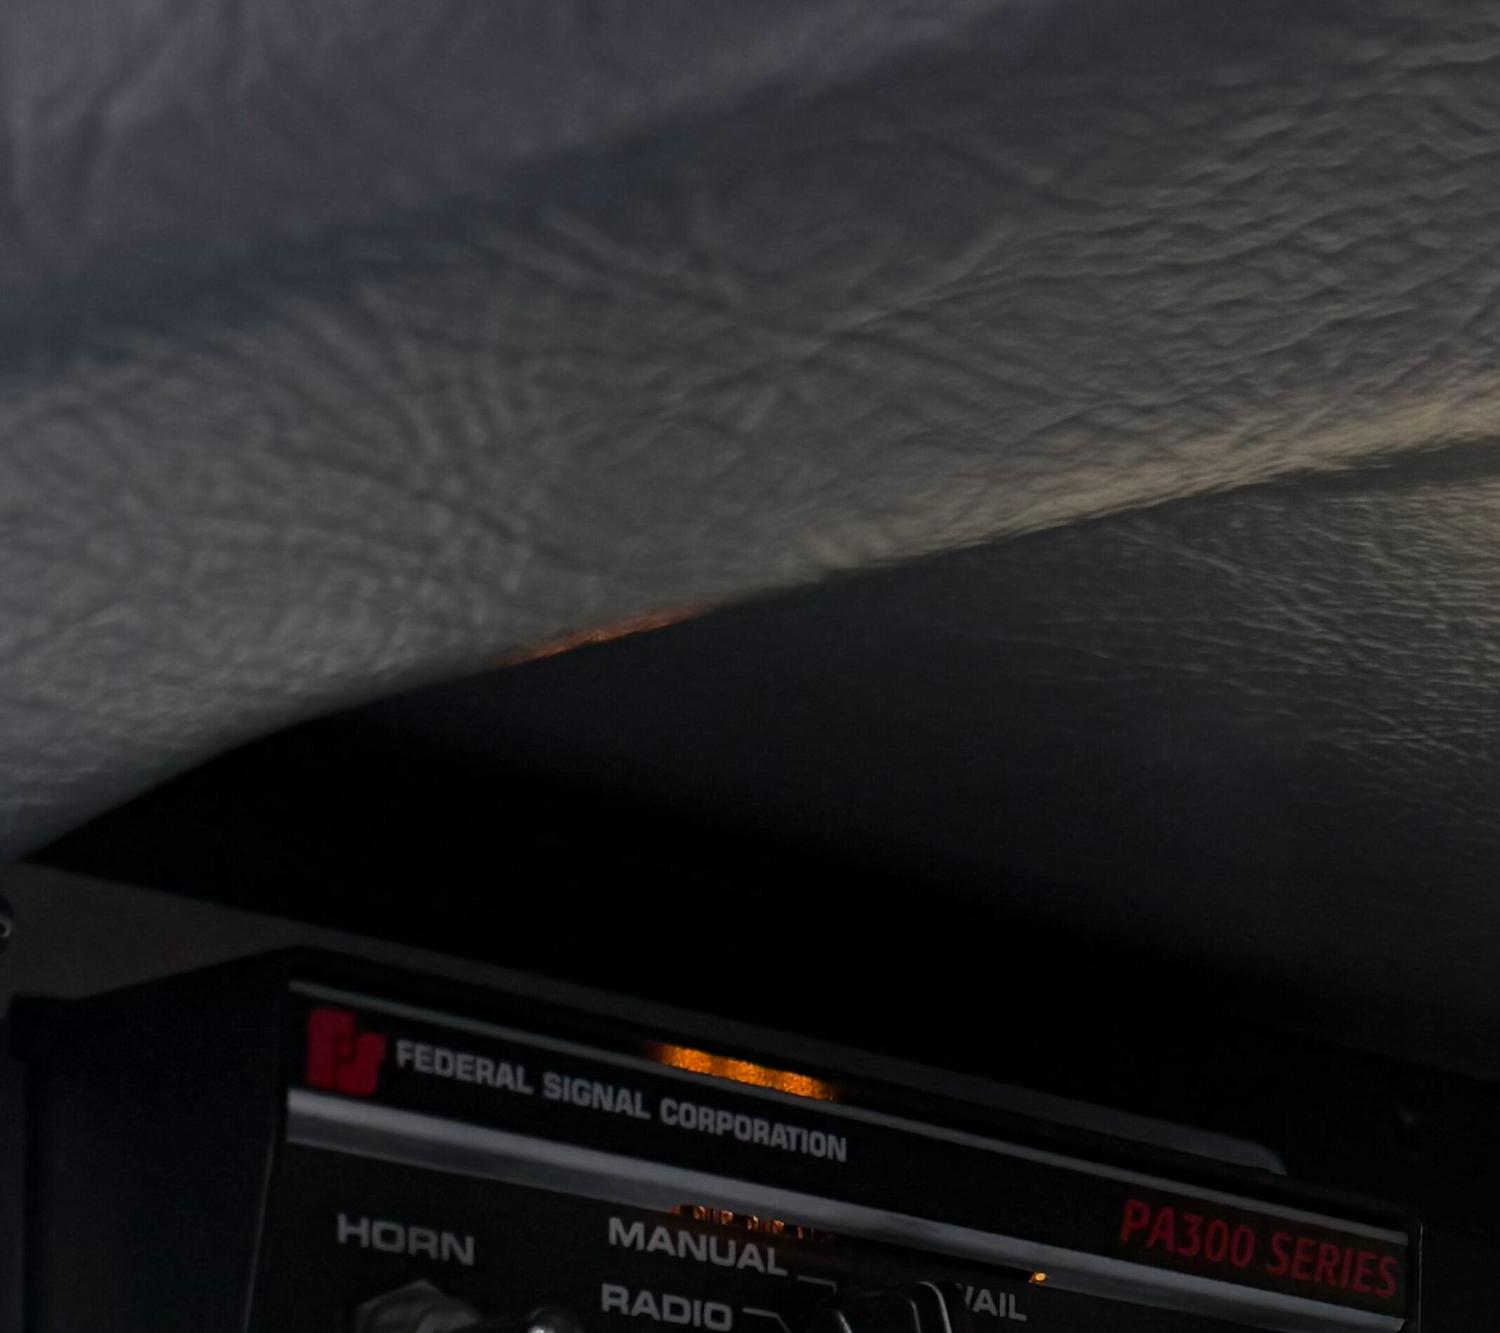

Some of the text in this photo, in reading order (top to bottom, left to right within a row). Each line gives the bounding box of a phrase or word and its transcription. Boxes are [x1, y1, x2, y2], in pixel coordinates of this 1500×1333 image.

[397, 1039, 847, 1162] FEDERAL SIGNAL CORPORATION
[337, 1213, 475, 1266] HORN
[607, 1216, 788, 1277] MANUAL
[1119, 1199, 1399, 1299] PA300 SERIES
[601, 1283, 733, 1333] RADIO
